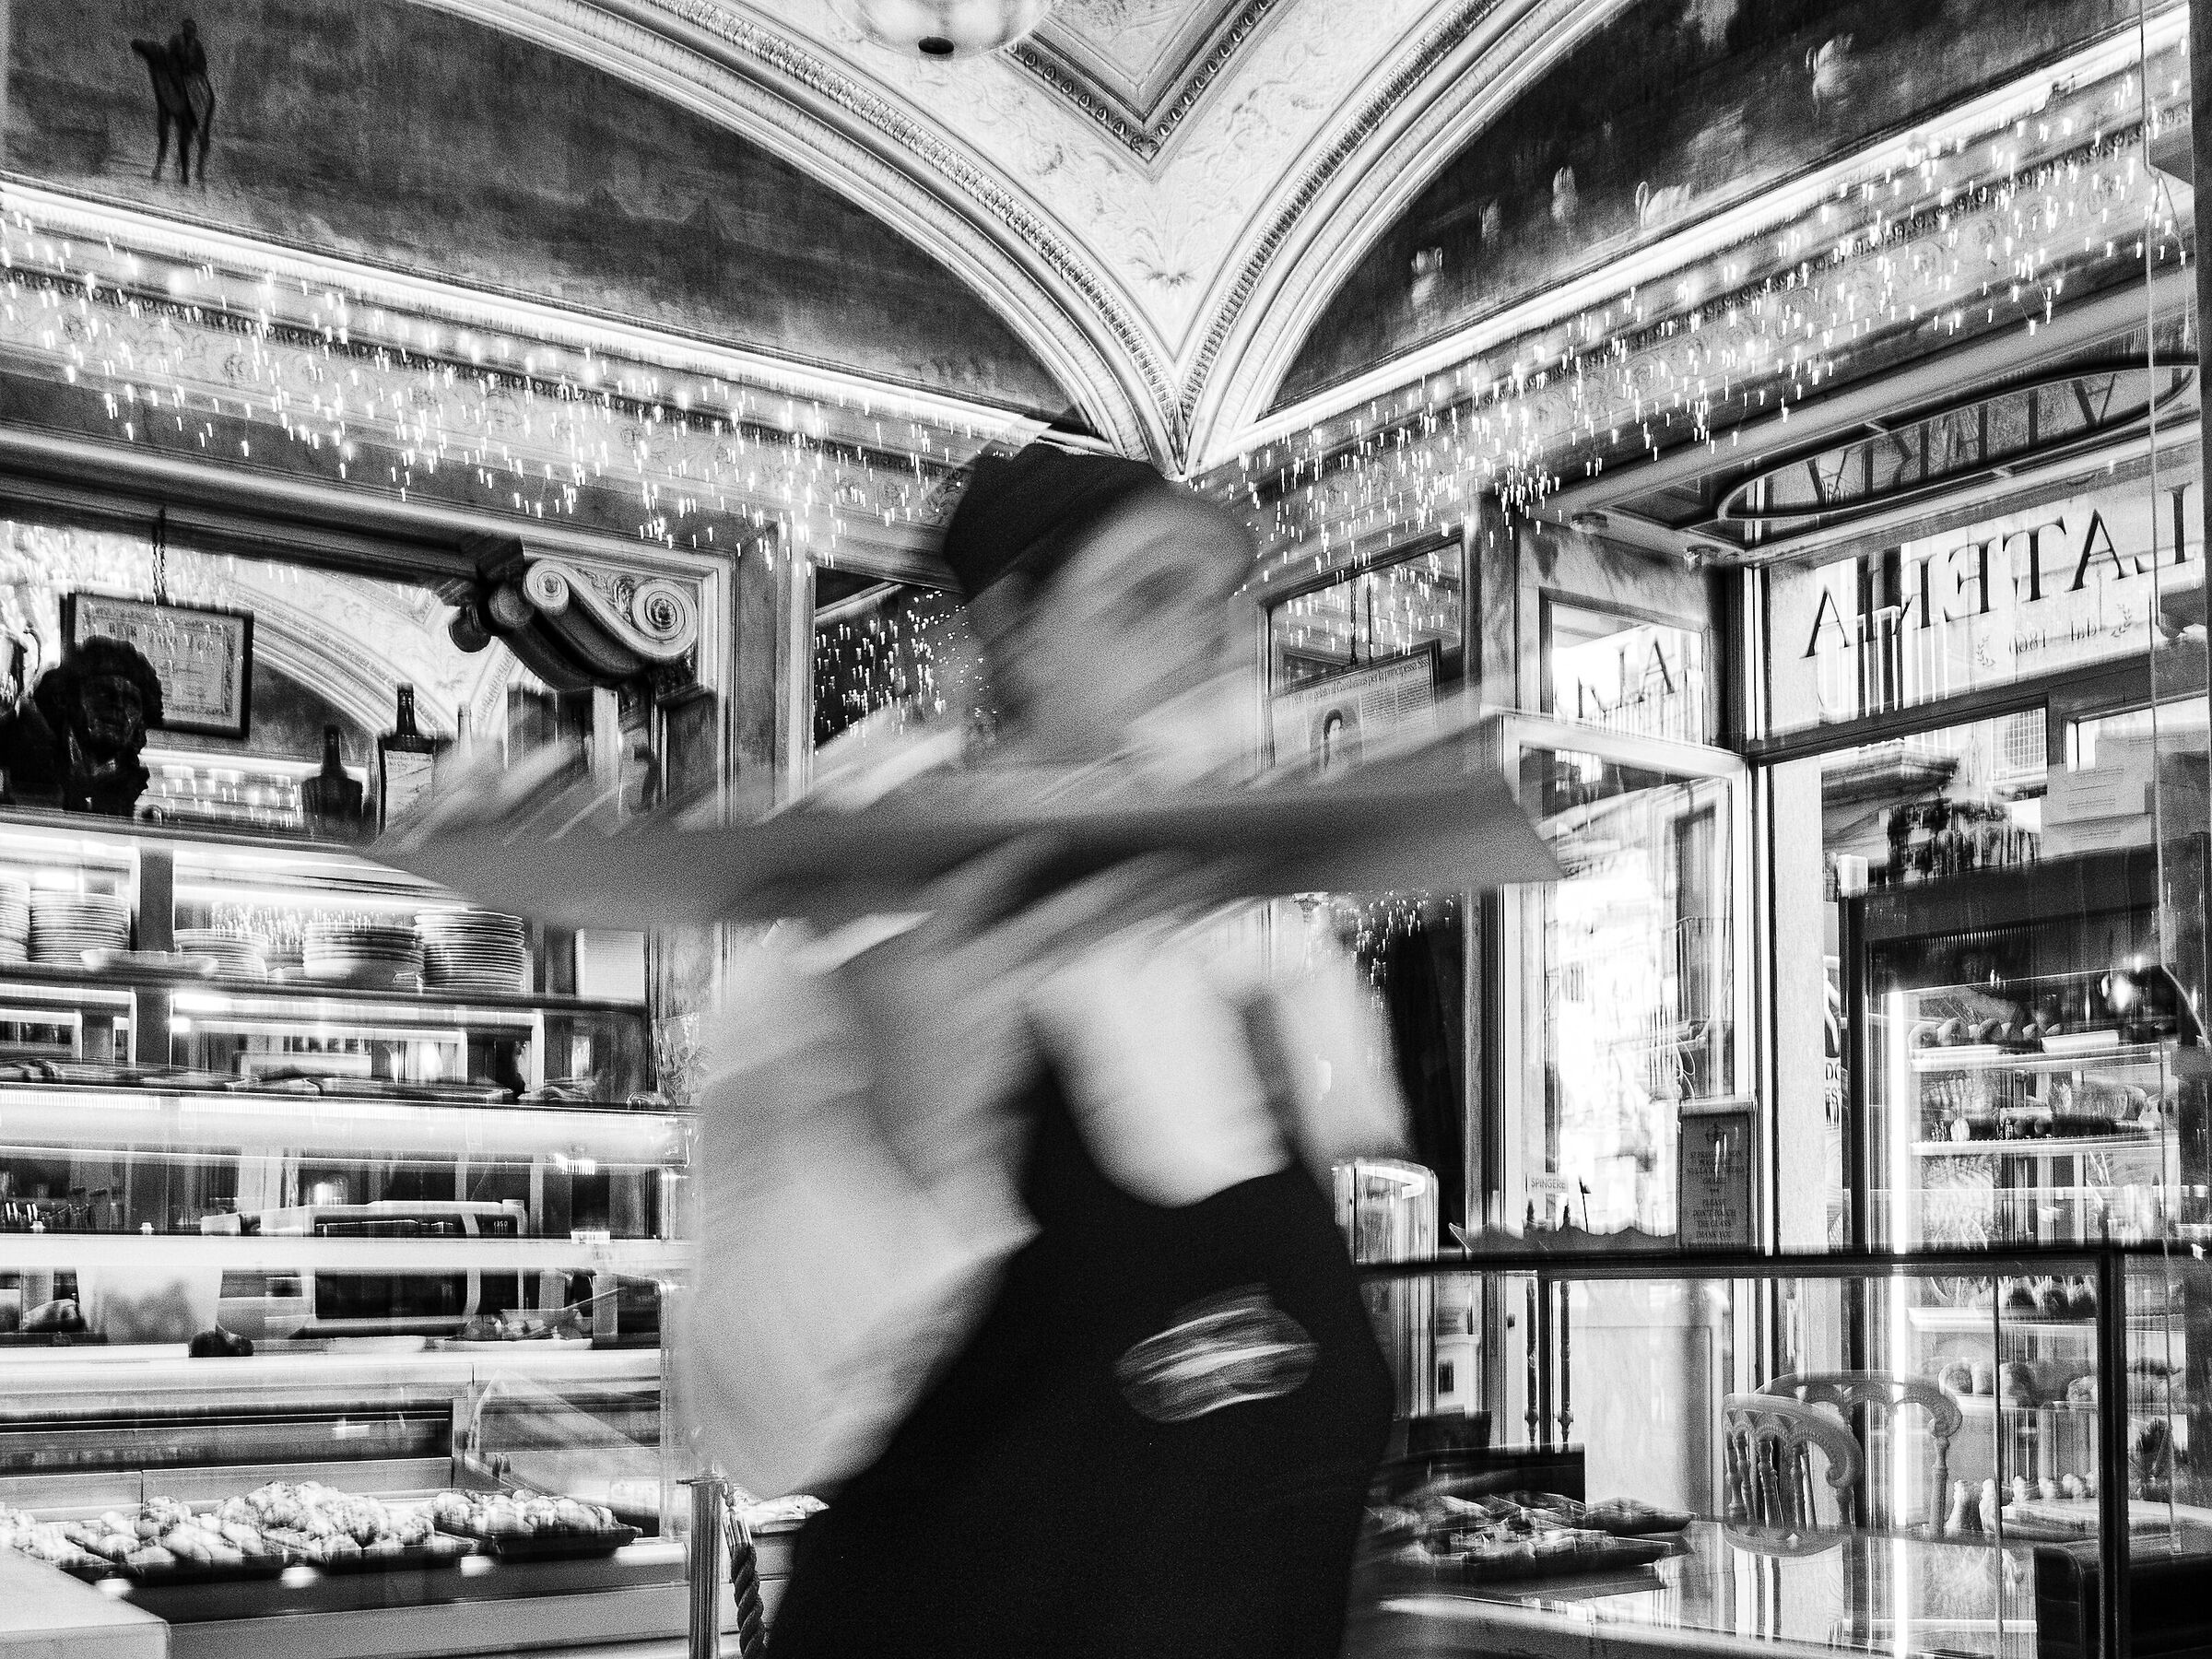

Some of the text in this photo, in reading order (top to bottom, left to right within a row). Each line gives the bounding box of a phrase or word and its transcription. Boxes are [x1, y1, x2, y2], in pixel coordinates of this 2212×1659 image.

[1368, 674, 1377, 686] per
[1384, 663, 1417, 682] principessa
[1531, 1177, 1566, 1189] SPINGERE
[1702, 1198, 1727, 1207] PLEASE
